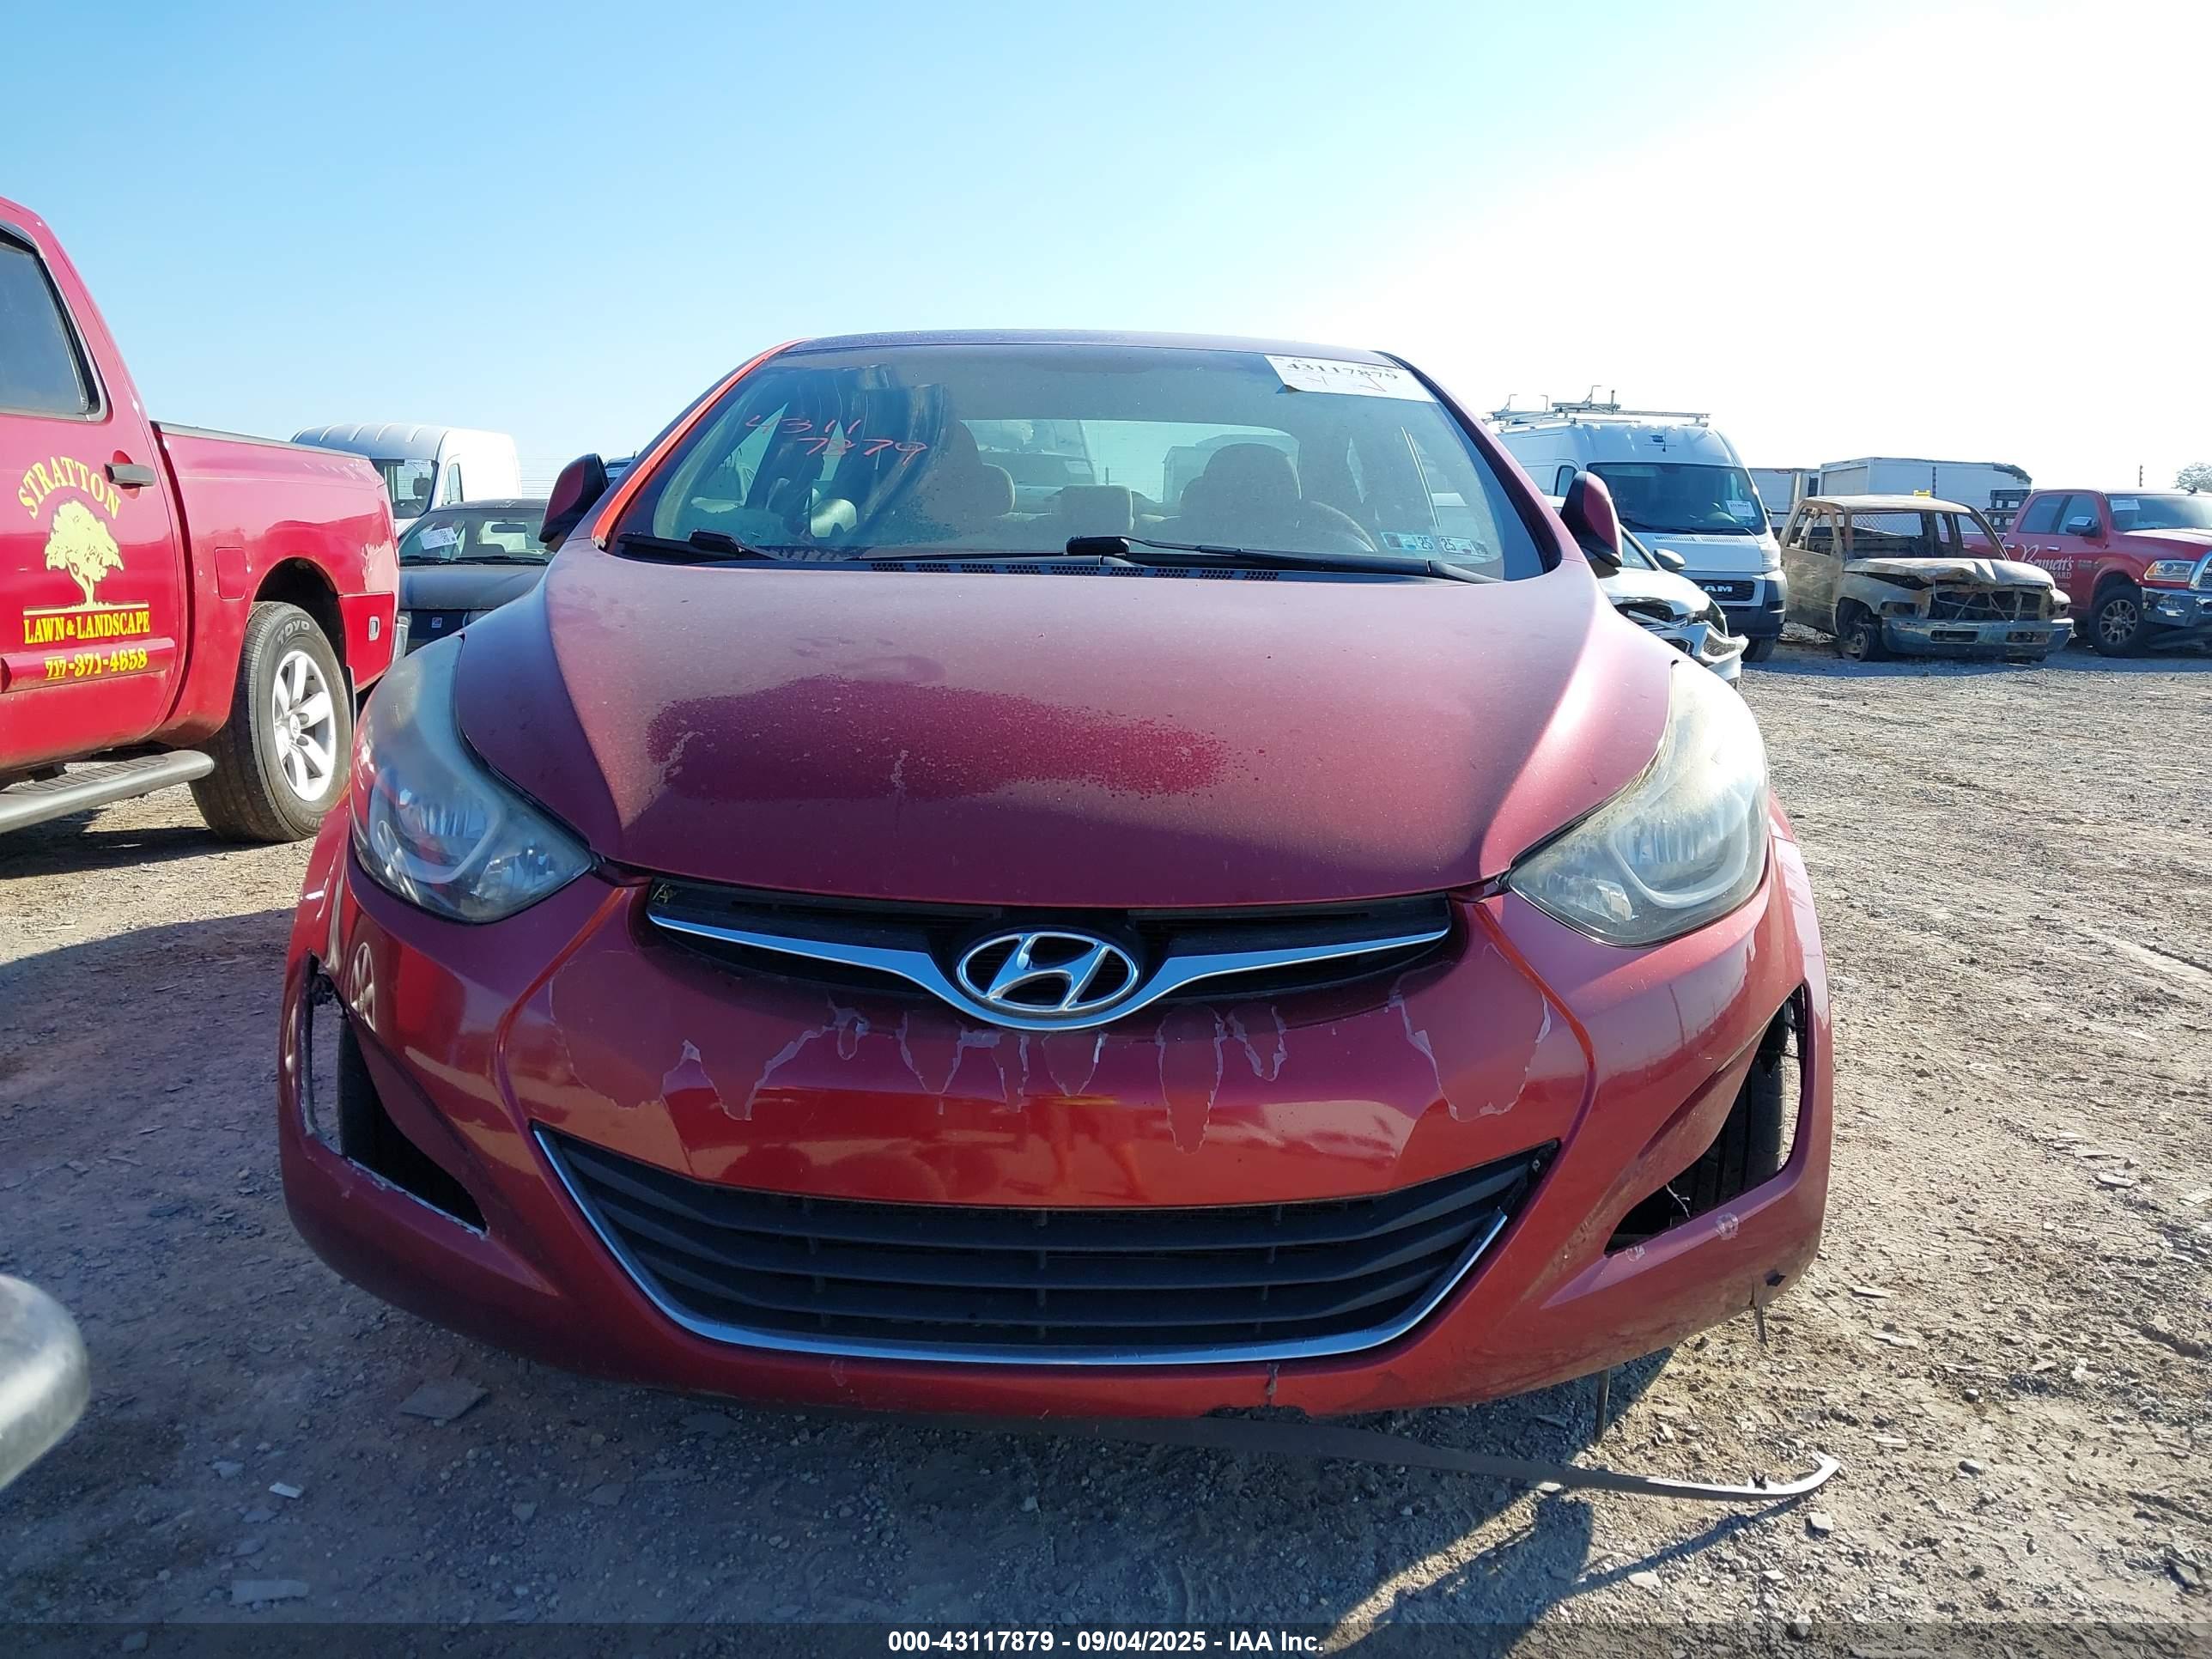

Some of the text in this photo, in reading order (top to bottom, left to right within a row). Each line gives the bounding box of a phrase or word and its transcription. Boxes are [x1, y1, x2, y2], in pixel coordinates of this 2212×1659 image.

[1287, 363, 1398, 379] 43117879
[17, 456, 122, 520] STRATTON
[1417, 536, 1434, 550] 25
[1440, 537, 1456, 551] 25
[277, 619, 310, 646] TOYO
[46, 647, 148, 679] 717-371-4658
